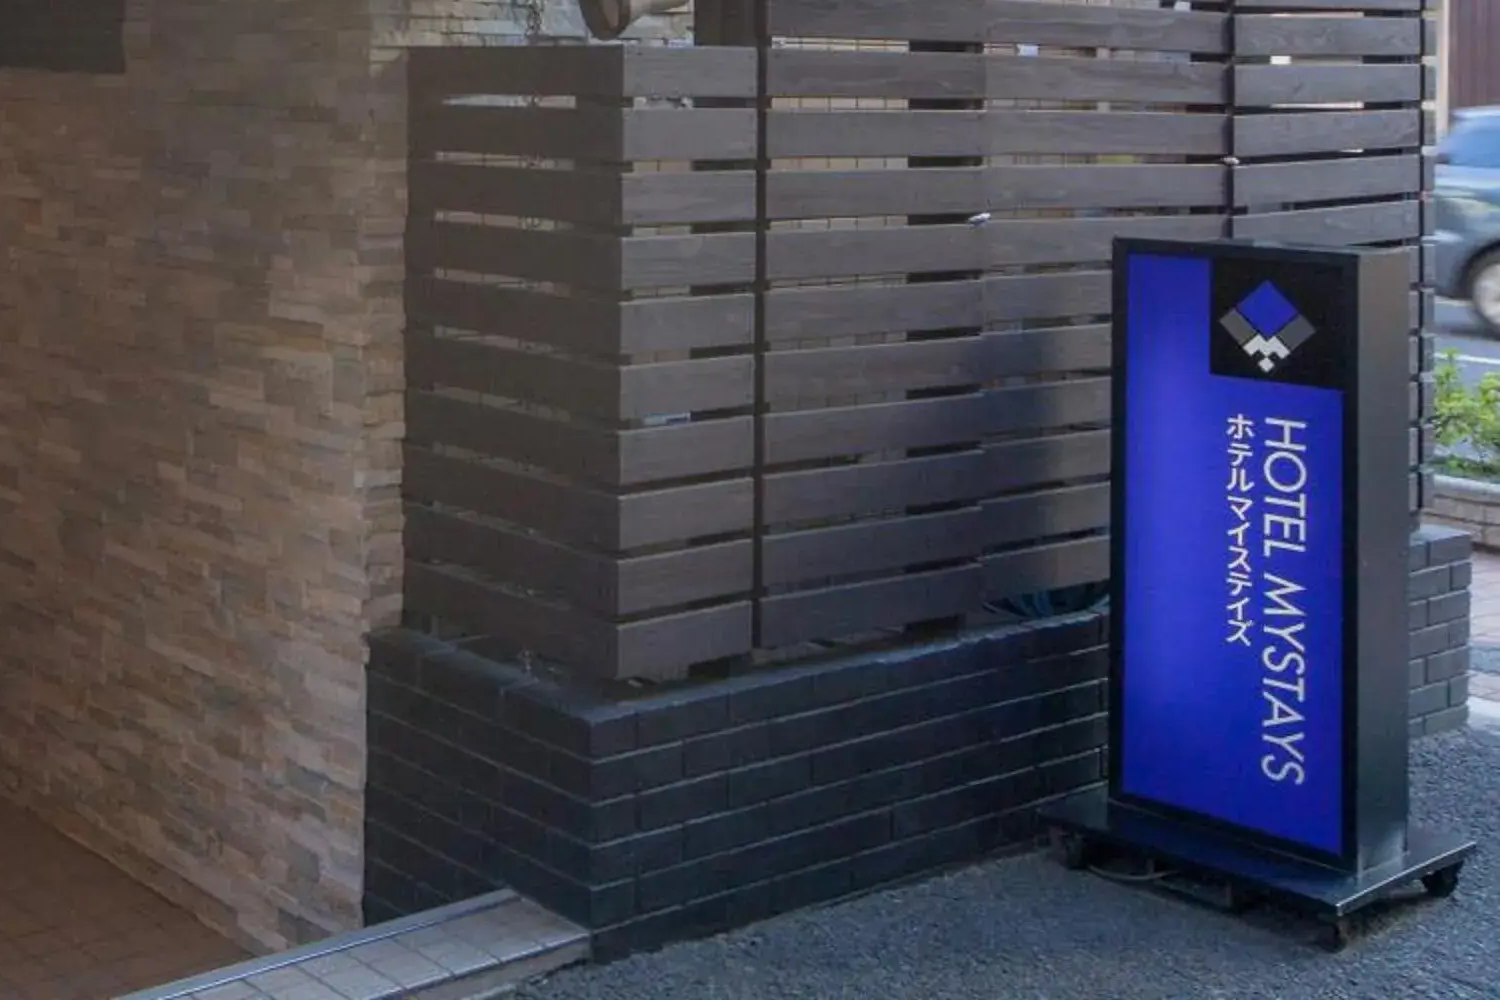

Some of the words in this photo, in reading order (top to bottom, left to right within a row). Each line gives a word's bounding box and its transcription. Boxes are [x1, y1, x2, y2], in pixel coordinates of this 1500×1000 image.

[1226, 413, 1255, 647] ホテルマイステイズ
[1263, 417, 1307, 557] HOTEL
[1262, 572, 1306, 784] MYSTAYS
